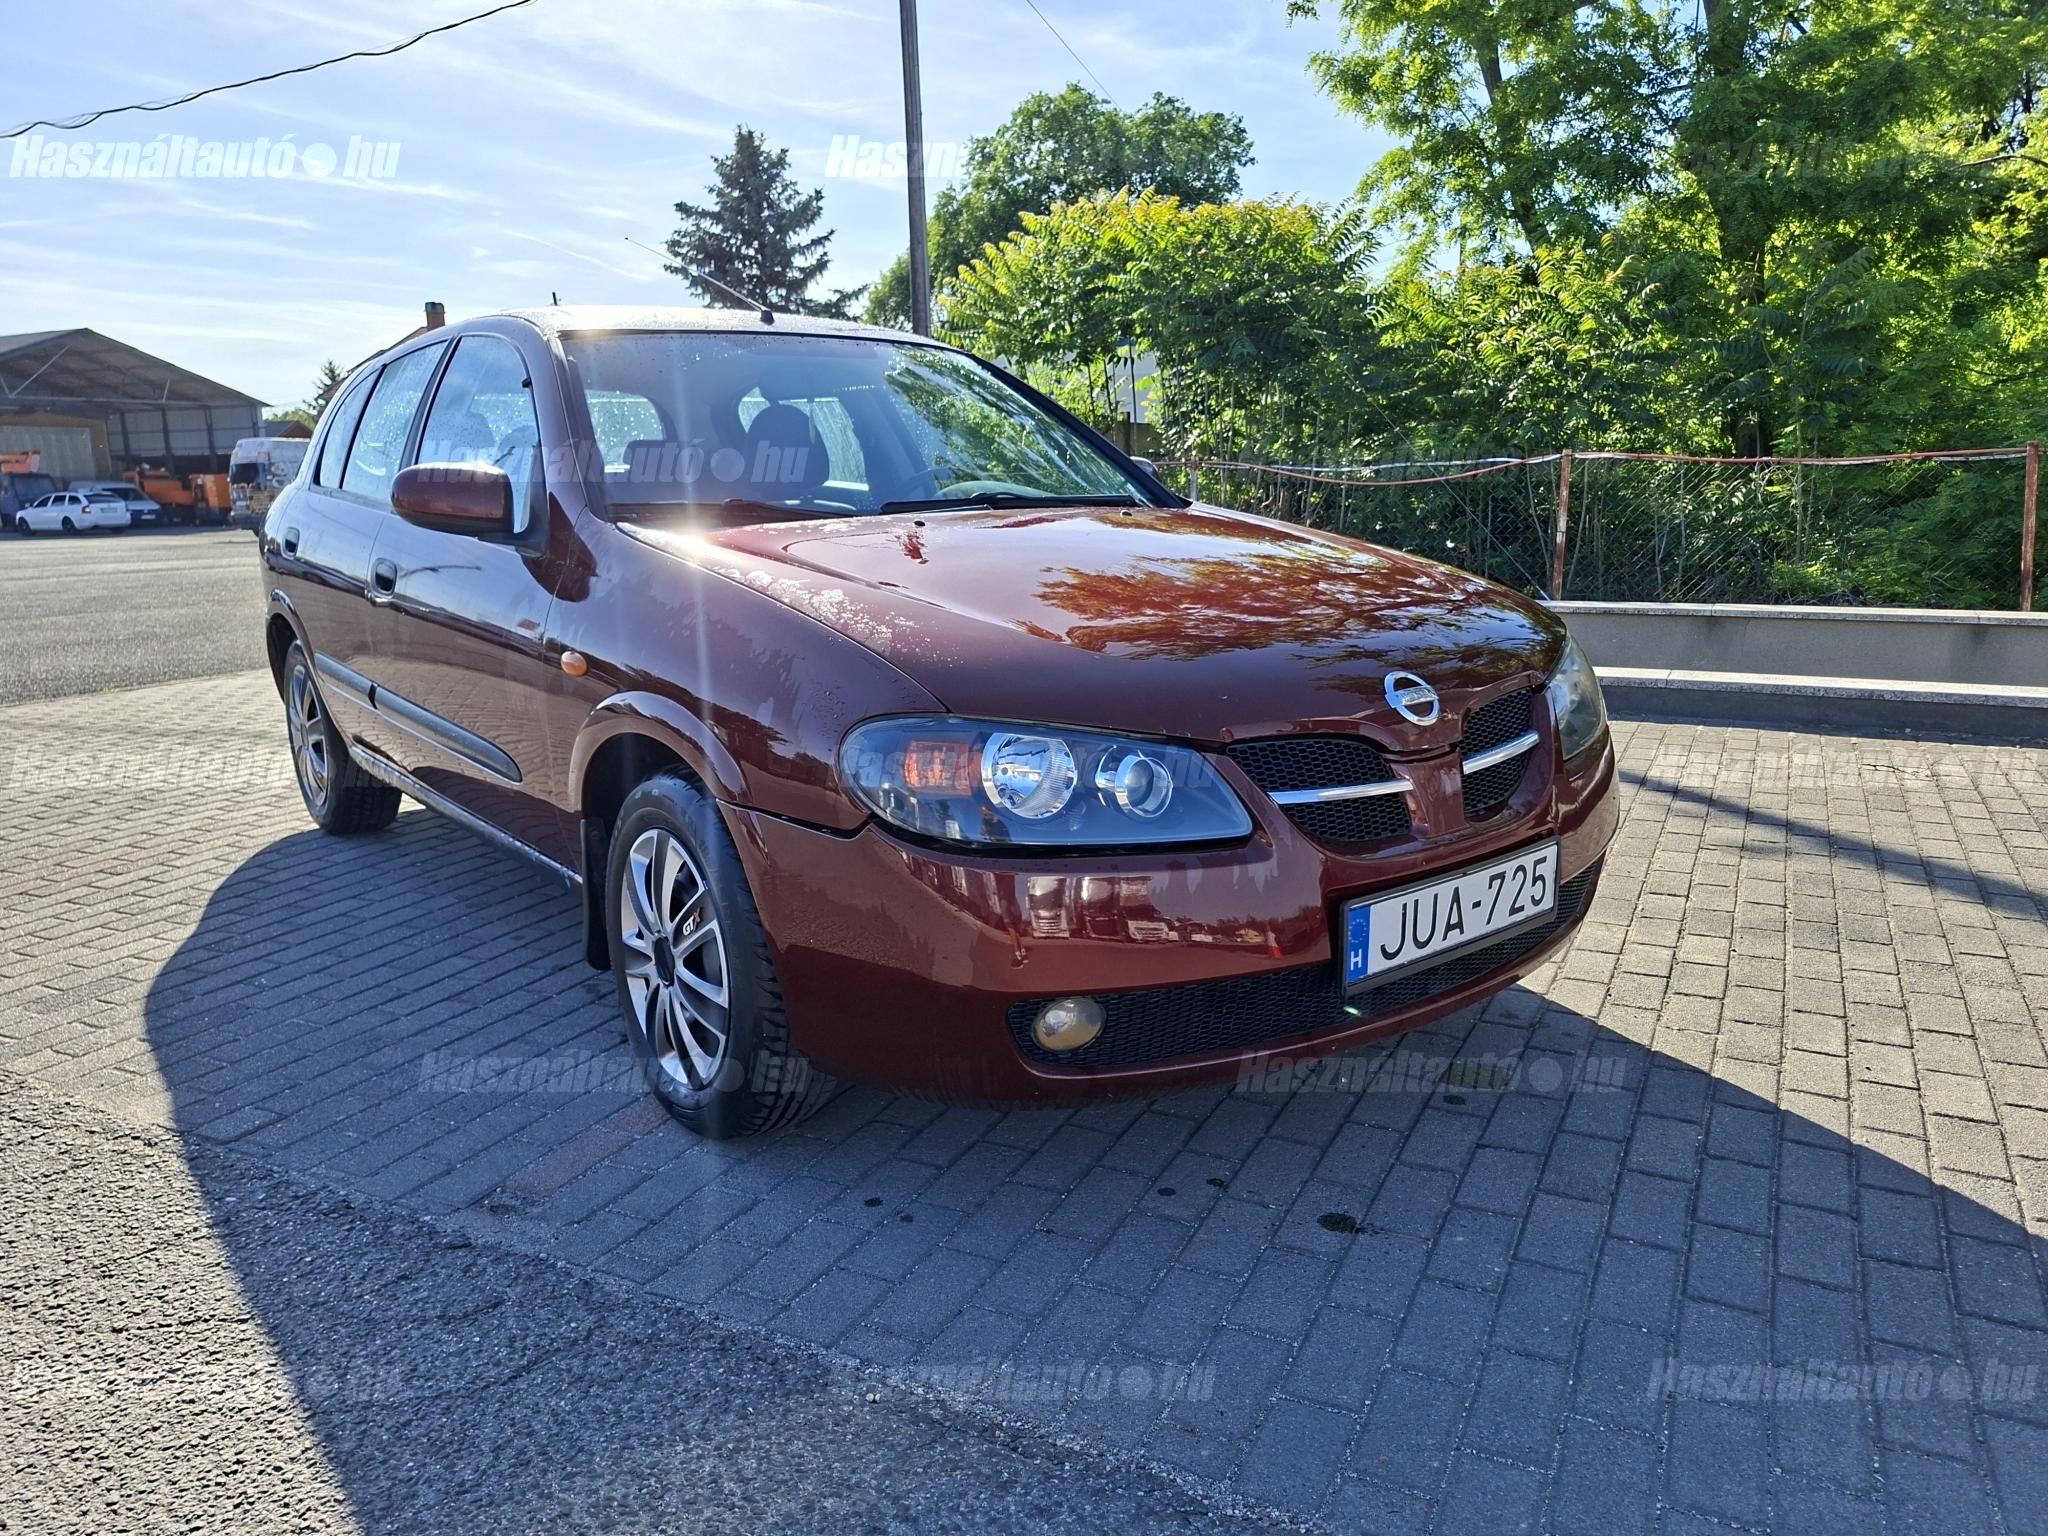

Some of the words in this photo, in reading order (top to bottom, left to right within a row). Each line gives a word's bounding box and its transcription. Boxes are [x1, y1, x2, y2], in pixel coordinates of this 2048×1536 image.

[683, 909, 701, 936] GTX
[1350, 949, 1362, 971] H
[1380, 856, 1548, 960] JUA-725
